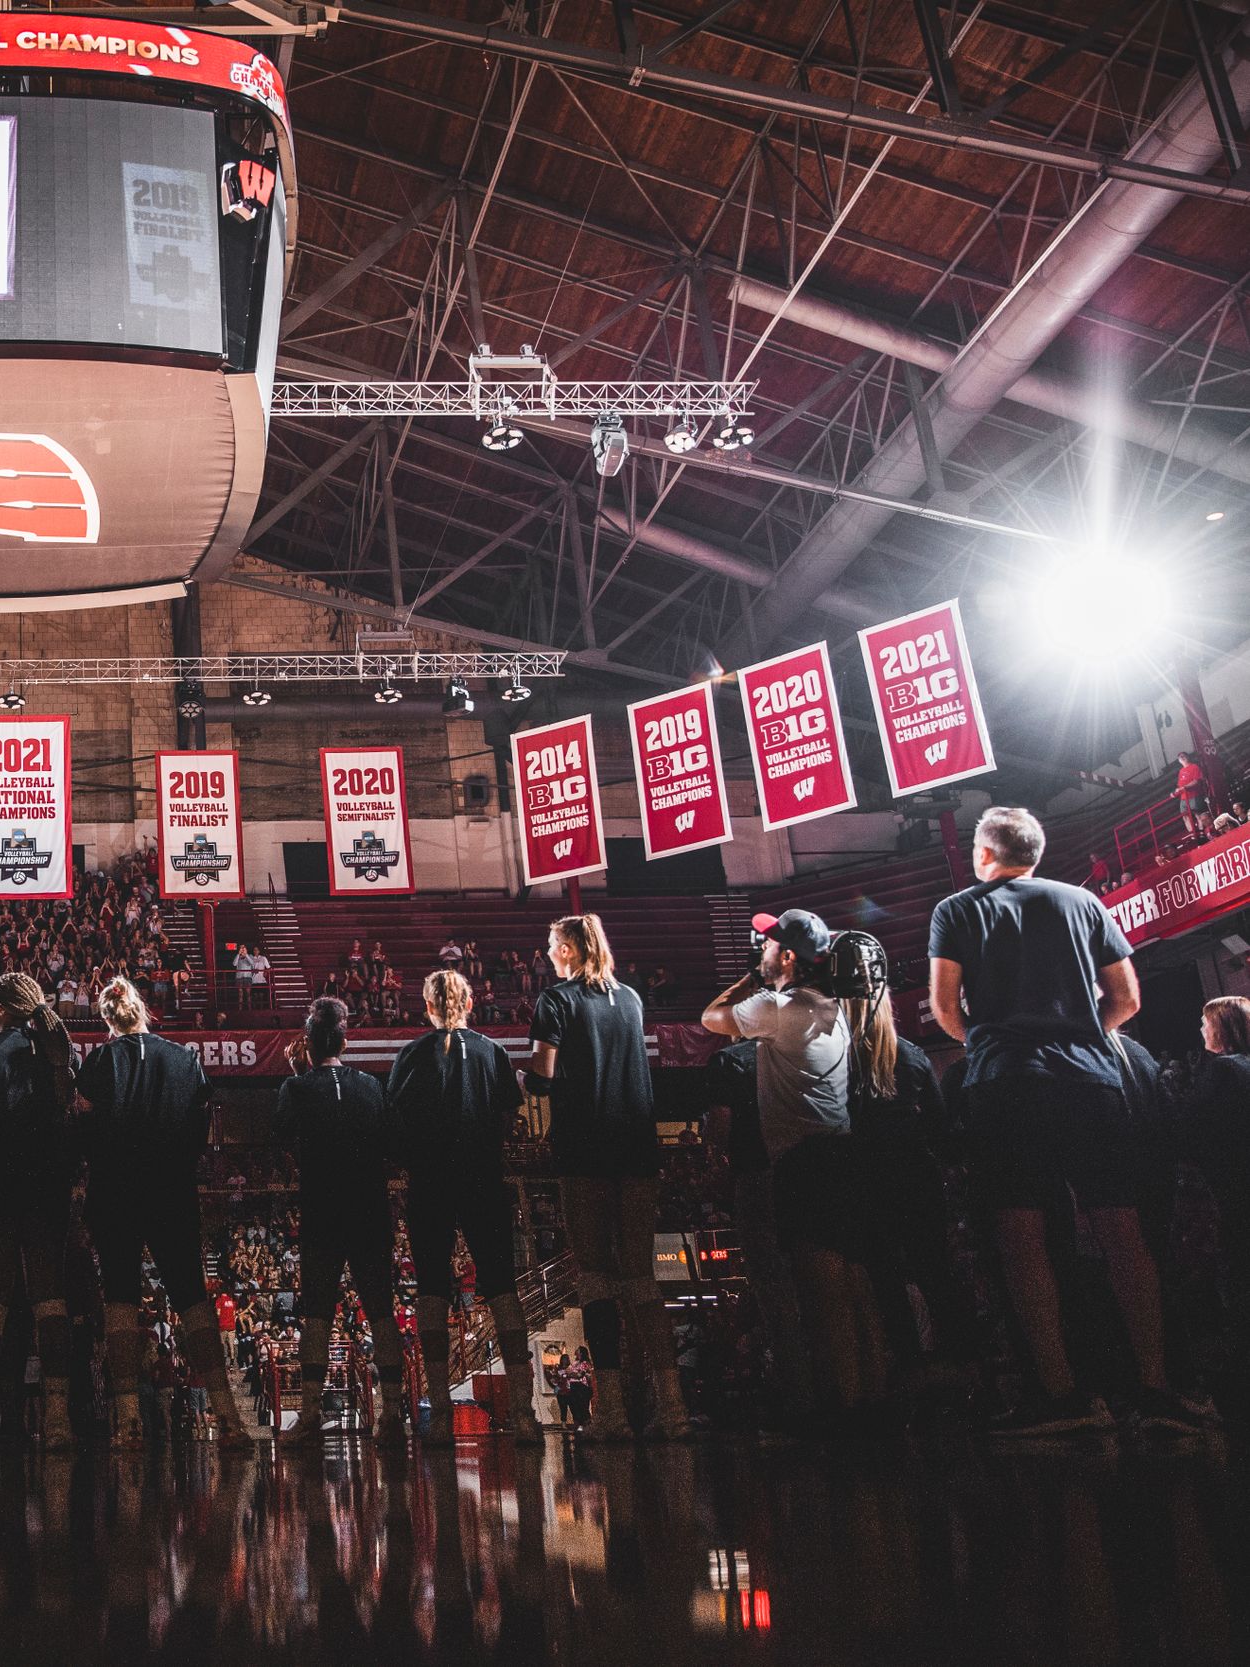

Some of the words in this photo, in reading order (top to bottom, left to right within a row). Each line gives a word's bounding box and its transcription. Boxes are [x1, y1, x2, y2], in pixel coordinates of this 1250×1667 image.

[16, 31, 200, 66] CHAMPIONS
[879, 629, 950, 681] 2021
[752, 669, 822, 720] 2020
[892, 699, 964, 730] VOLLEYBALL
[895, 712, 967, 744] CHAMPIONS
[644, 708, 702, 752] 2019
[525, 740, 582, 780] 2014
[766, 738, 830, 766] VOLLEYBALL
[768, 750, 832, 780] CHAMPIONS
[170, 771, 225, 798] 2019
[332, 768, 395, 796] 2020
[650, 774, 710, 798] VOLLEYBALL
[170, 803, 228, 812] VOLLEYBALL
[336, 802, 394, 812] VOLLEYBALL
[652, 786, 712, 811] CHAMPIONS
[170, 815, 228, 826] FINALIST
[337, 812, 396, 822] SEMIFINALIST
[531, 804, 588, 825] VOLLEYBALL
[532, 816, 590, 838] CHAMPIONS
[346, 856, 396, 864] CHAMPIONSHIP
[1156, 839, 1250, 916] FORWAR
[656, 1254, 677, 1262] BMO
